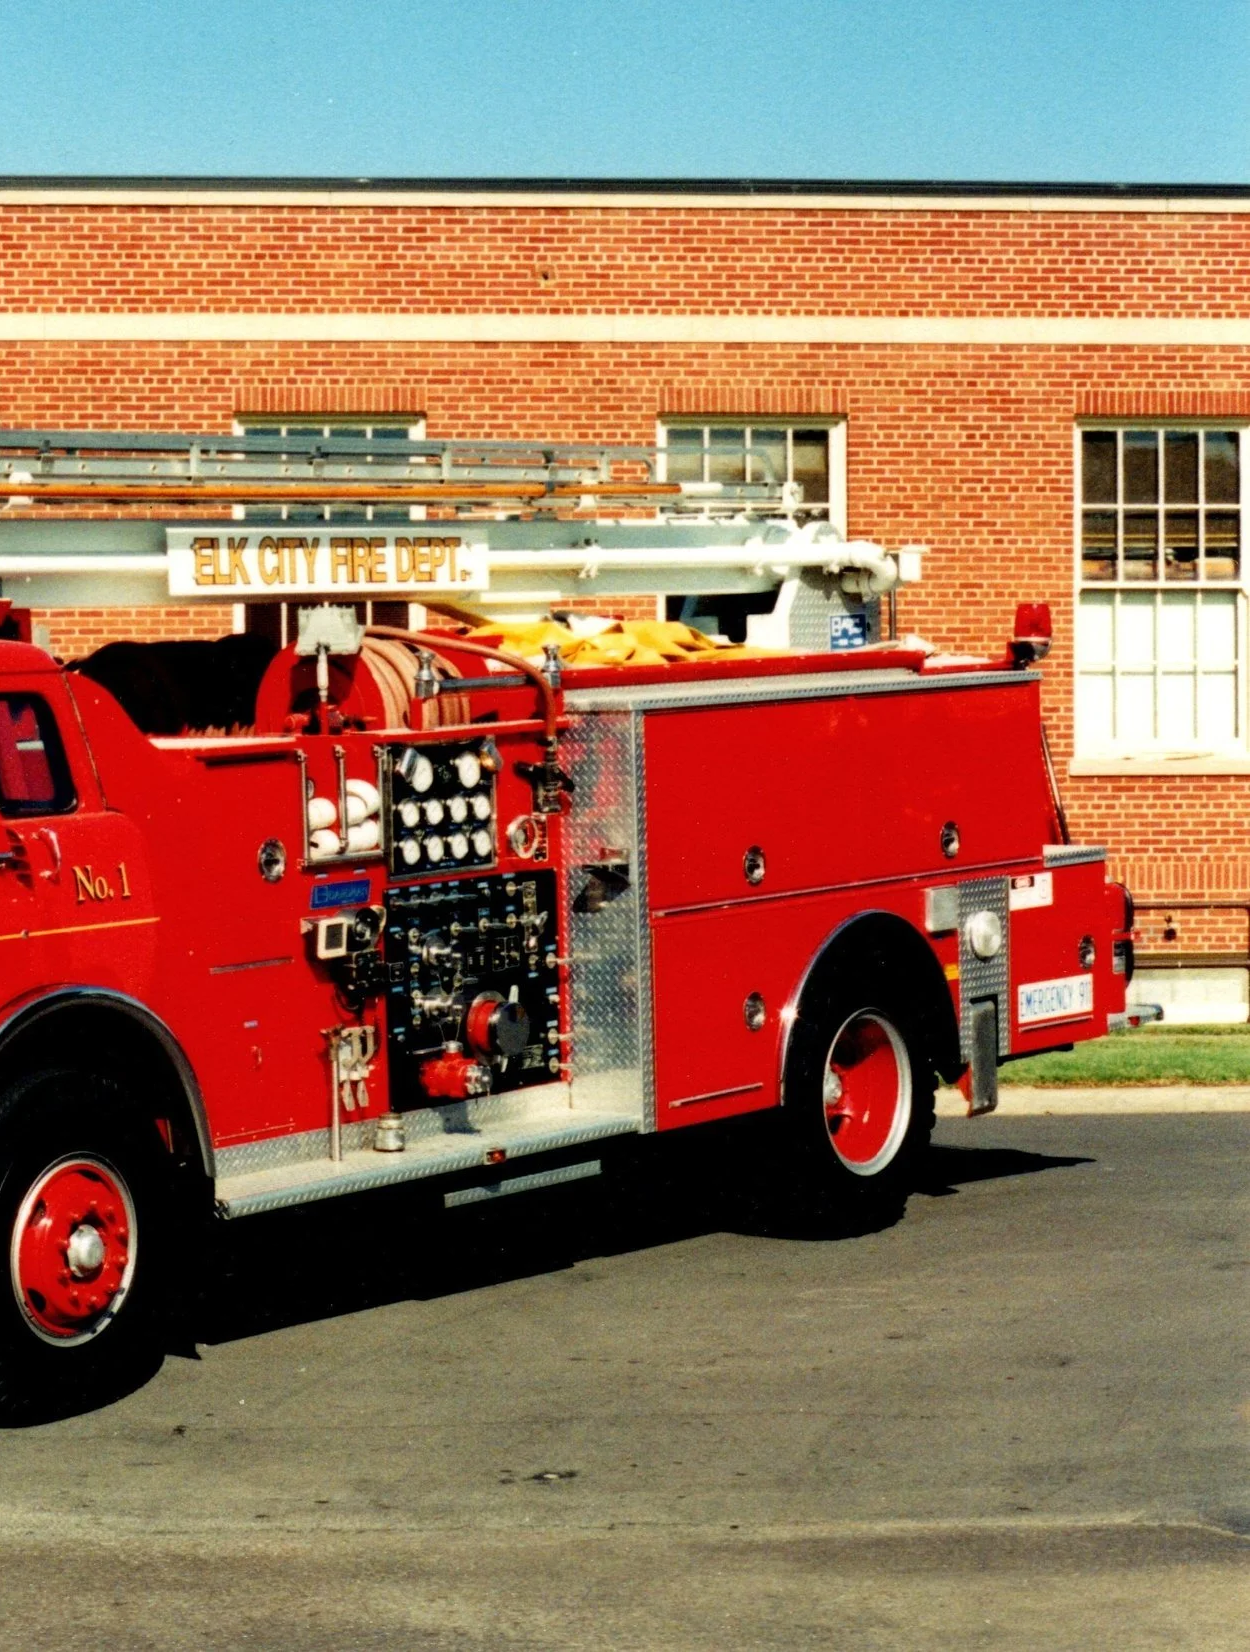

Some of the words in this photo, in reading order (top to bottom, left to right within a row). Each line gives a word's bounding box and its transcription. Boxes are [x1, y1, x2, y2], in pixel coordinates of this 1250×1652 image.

[193, 537, 251, 585] ELK
[258, 536, 321, 585] CITY
[329, 537, 387, 584] FIRE
[395, 537, 468, 583] DEPT.
[72, 864, 115, 902] No.
[118, 861, 132, 898] 1
[1020, 984, 1073, 1017] EMERGENCY
